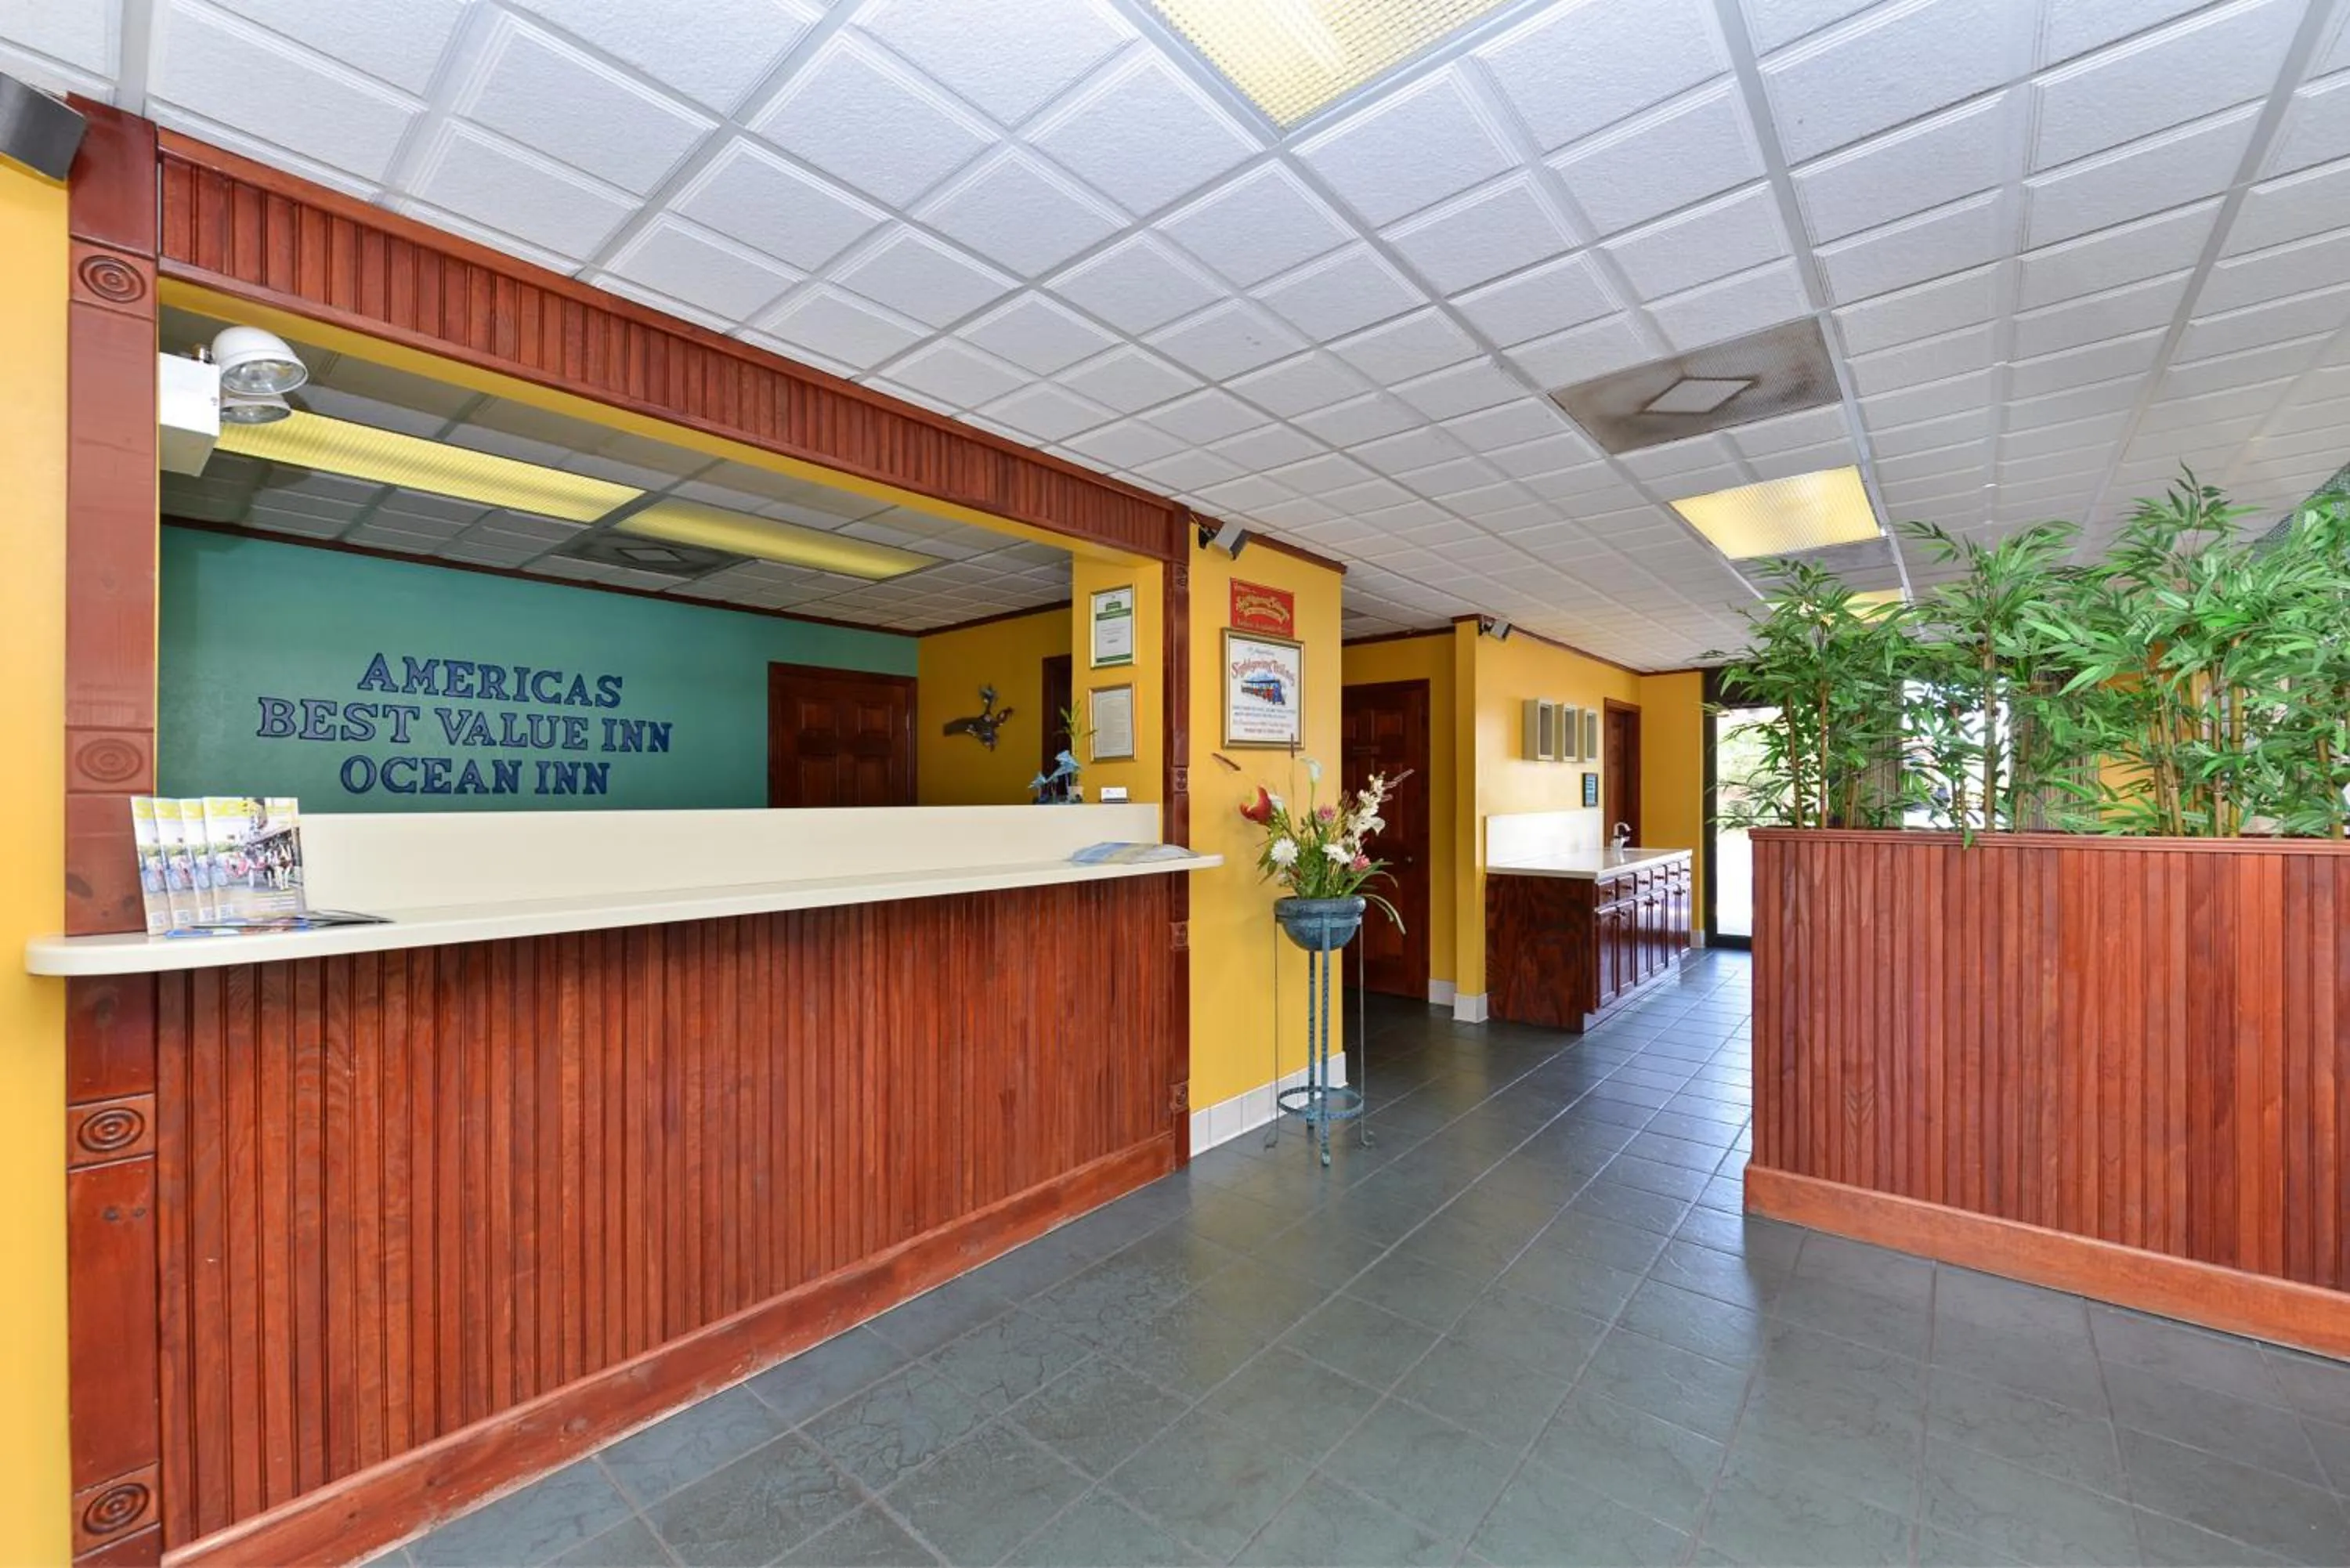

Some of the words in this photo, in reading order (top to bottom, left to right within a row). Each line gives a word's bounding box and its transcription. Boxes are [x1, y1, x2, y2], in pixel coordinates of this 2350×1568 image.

[357, 652, 624, 710] AMERICAS
[257, 695, 421, 745] BEST
[434, 706, 589, 751] VALUE
[600, 717, 674, 753] INN
[340, 754, 522, 796] OCEAN
[535, 760, 612, 796] INN
